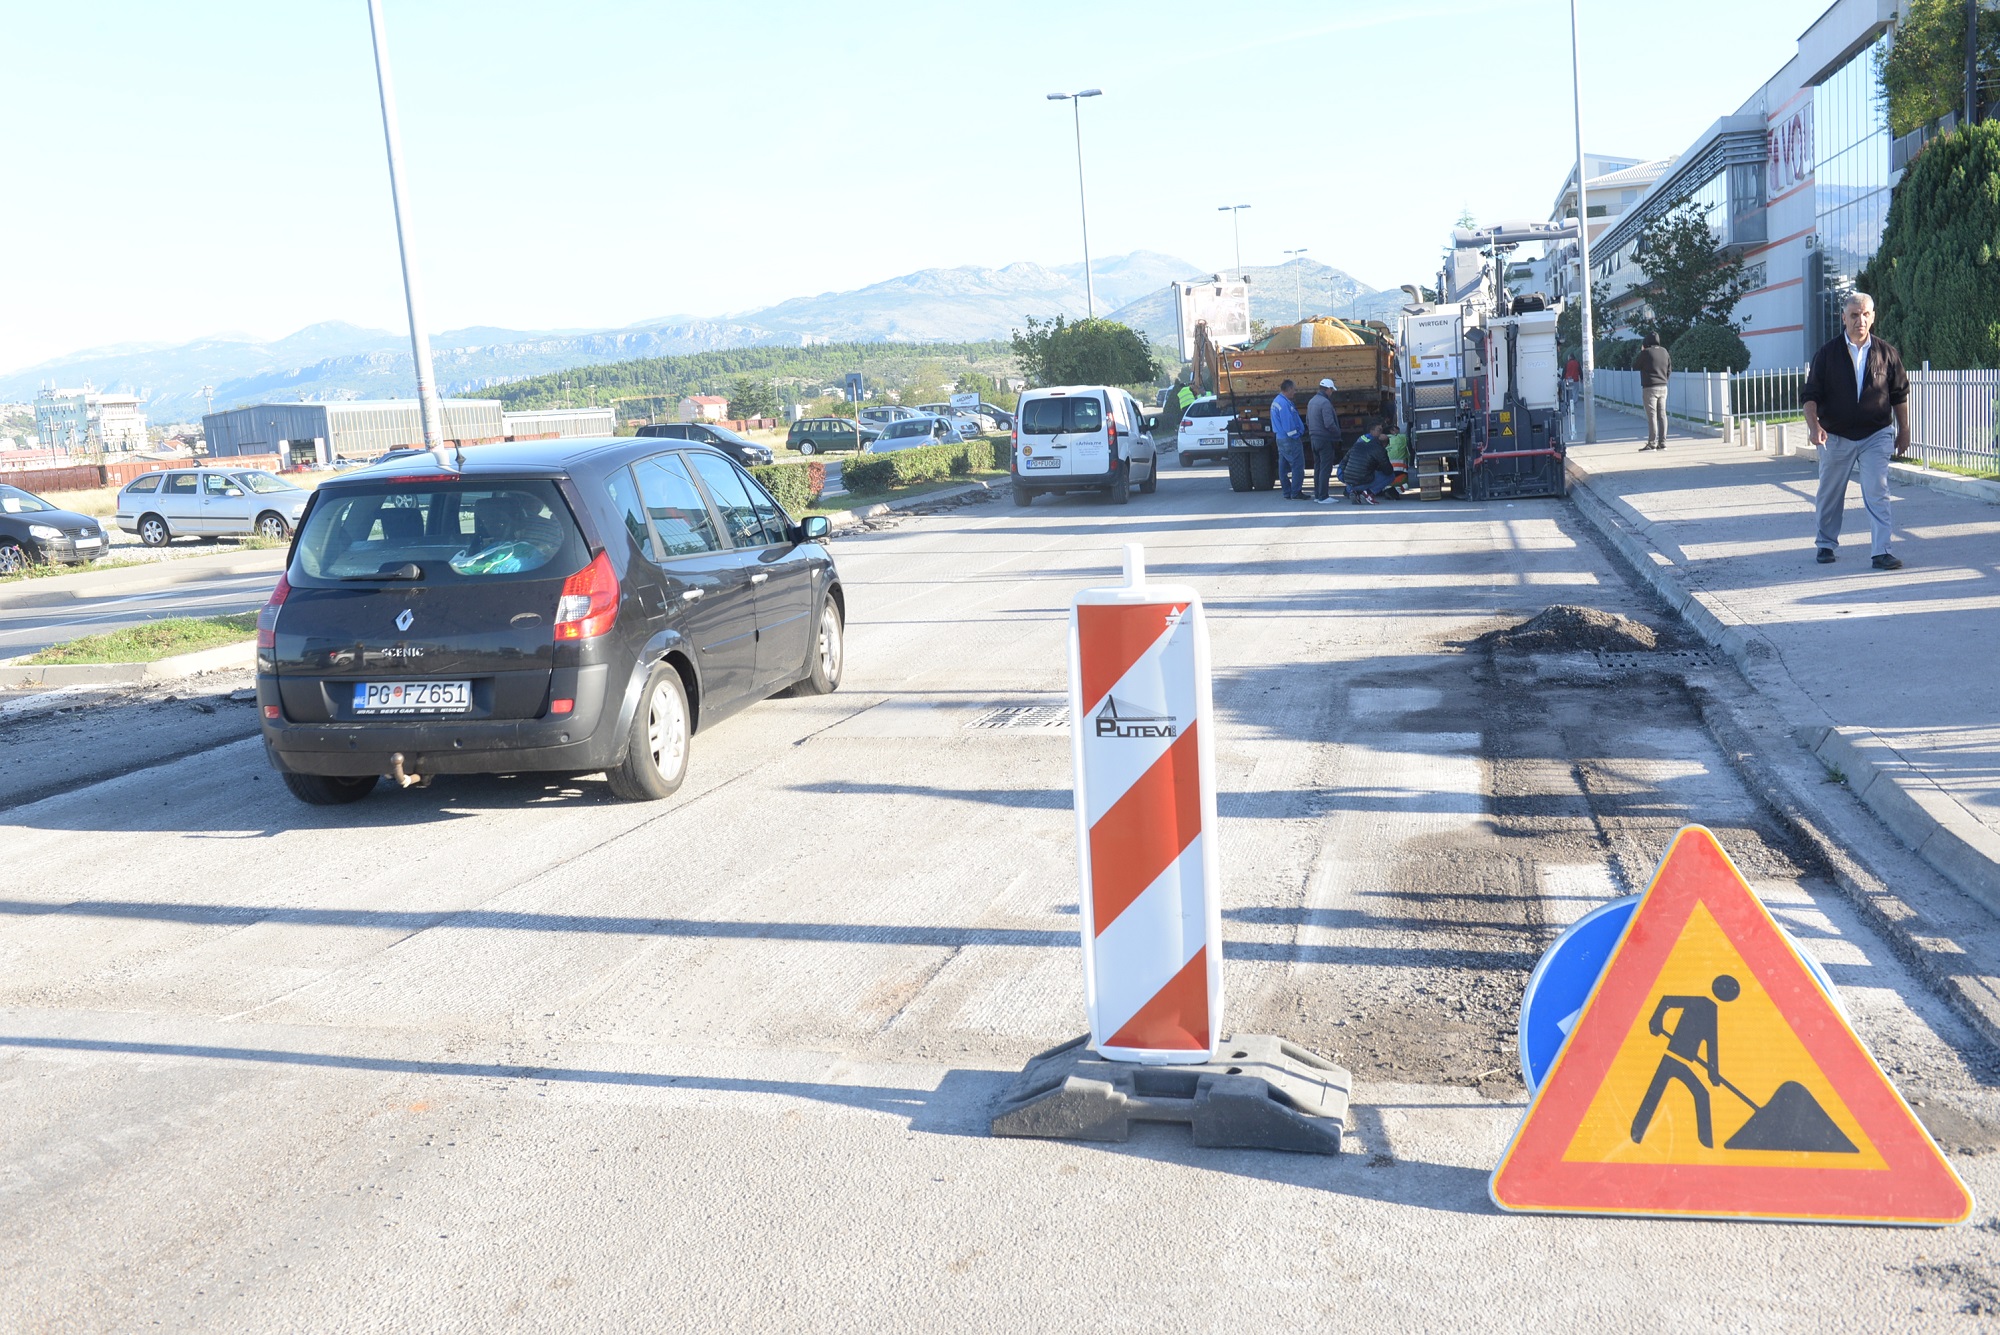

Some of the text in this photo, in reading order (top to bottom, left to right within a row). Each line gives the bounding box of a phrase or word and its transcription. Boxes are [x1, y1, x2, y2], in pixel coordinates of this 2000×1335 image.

[1418, 320, 1449, 328] WIRTGEN
[381, 647, 424, 658] SCENIC
[367, 683, 467, 705] PG FZ651
